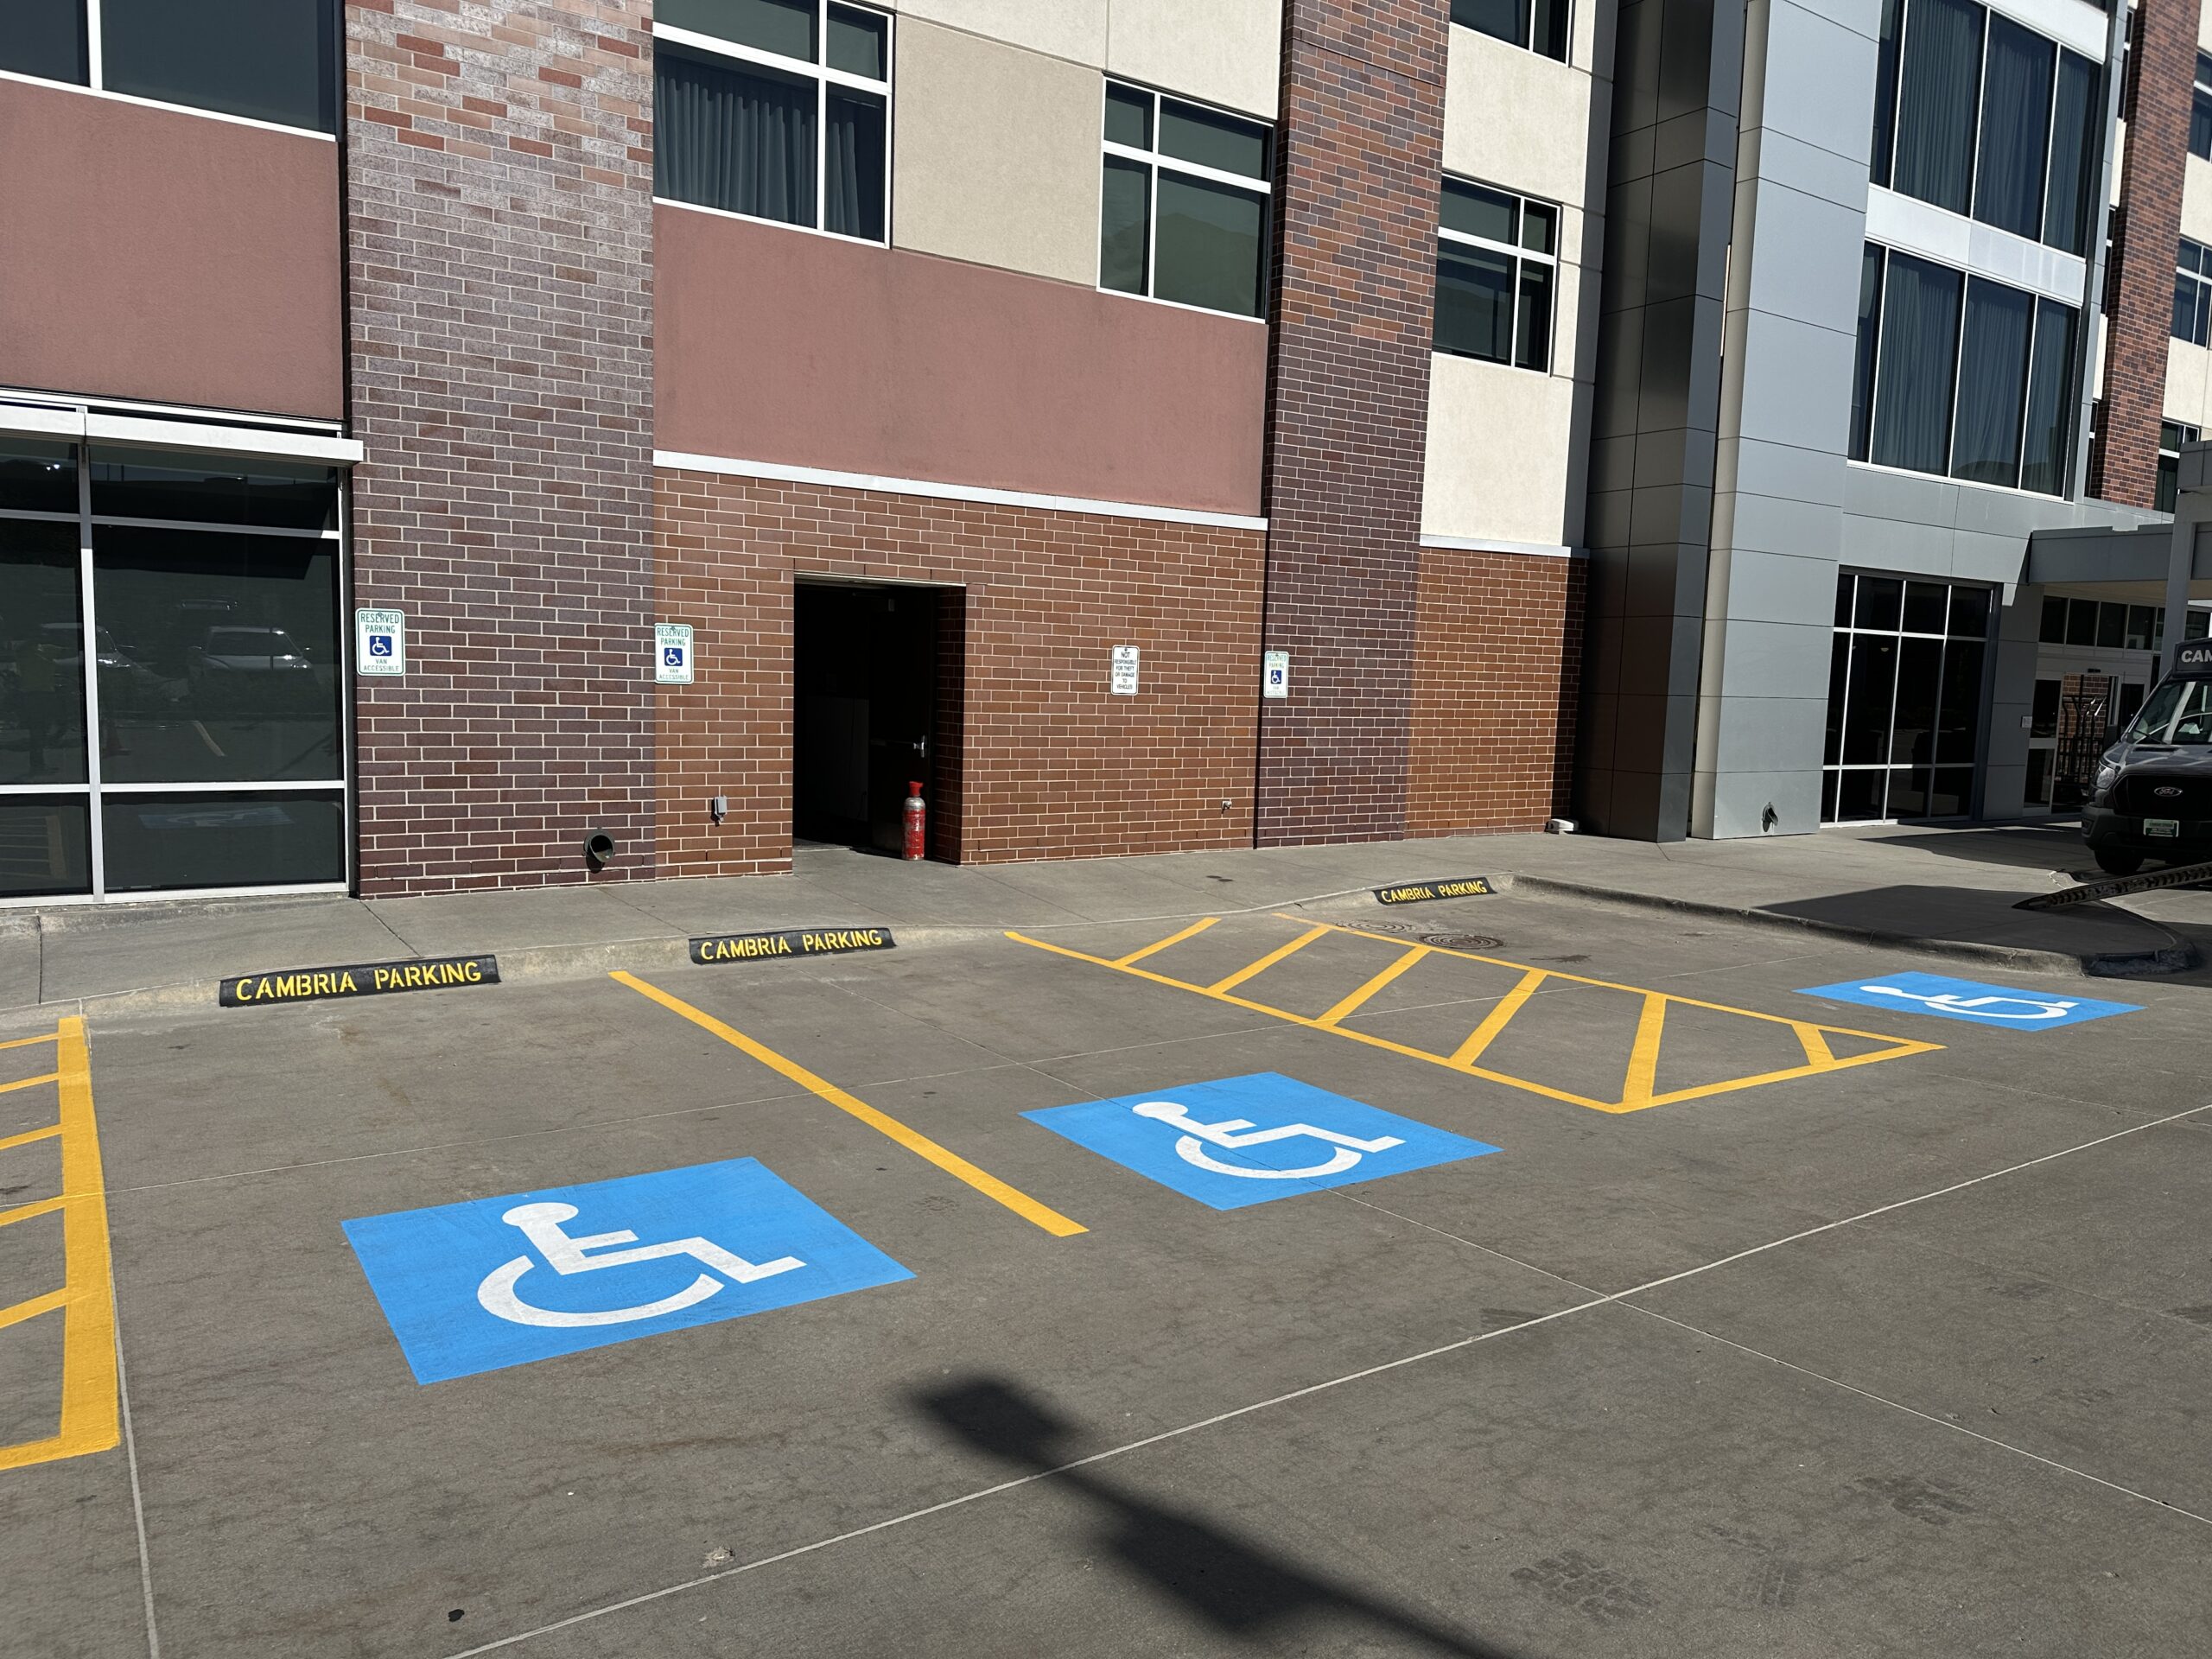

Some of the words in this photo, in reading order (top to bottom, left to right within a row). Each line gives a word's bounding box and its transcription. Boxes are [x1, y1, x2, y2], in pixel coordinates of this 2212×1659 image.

[360, 613, 399, 624] RESERVED
[365, 624, 396, 634] PARKING
[657, 627, 690, 638] RESERVED
[660, 638, 686, 646] PARKING
[1381, 887, 1436, 903] CAMBRIA
[1438, 880, 1488, 897] PARKING
[701, 936, 792, 960] CAMBRIA
[802, 929, 882, 952] PARKING
[235, 971, 358, 1001] CAMBRIA
[374, 961, 482, 990] PARKING
